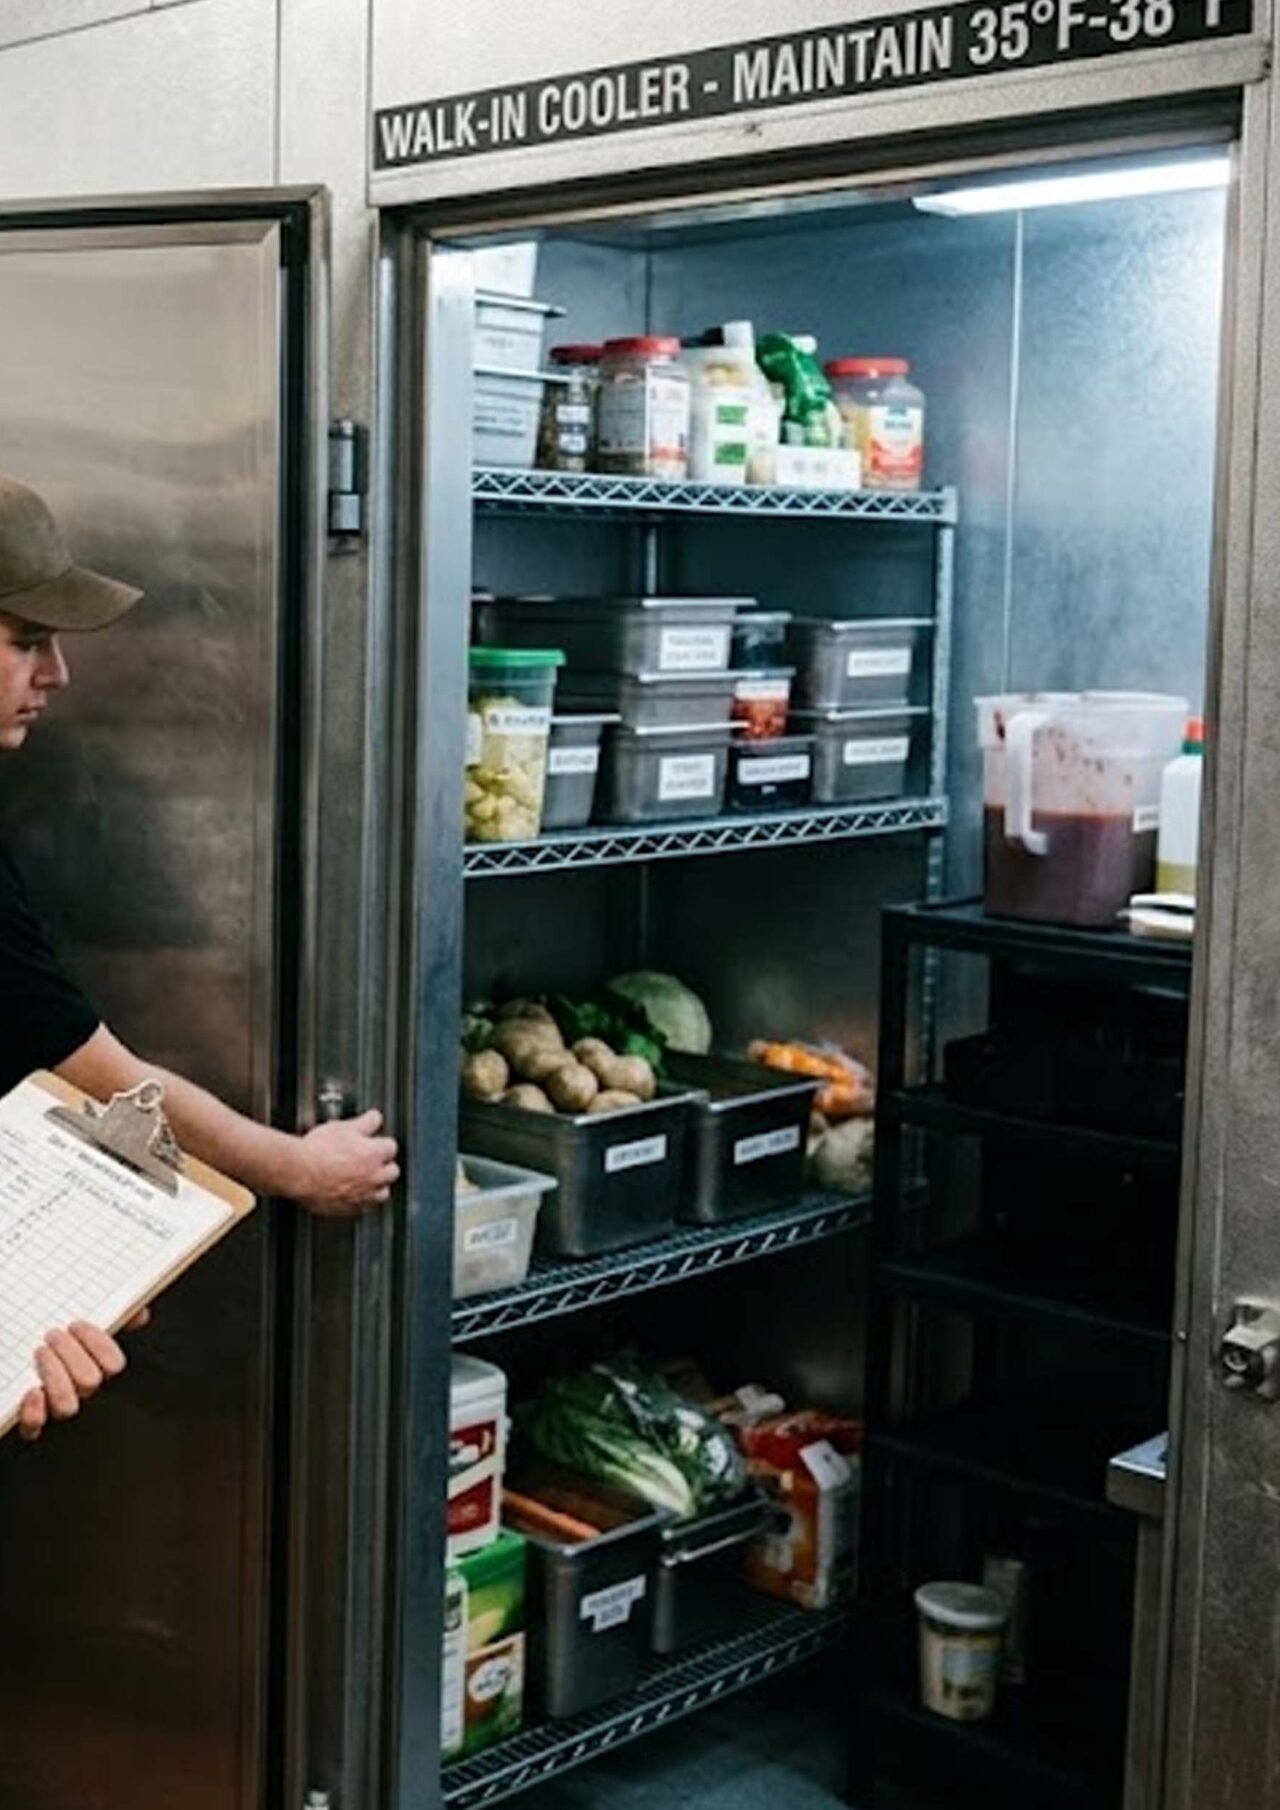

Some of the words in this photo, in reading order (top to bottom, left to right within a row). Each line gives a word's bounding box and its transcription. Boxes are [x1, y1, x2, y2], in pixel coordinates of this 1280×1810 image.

[379, 91, 526, 160] WALK-IN
[538, 63, 690, 135] COOLER
[733, 15, 952, 104] MAINTAIN
[969, 0, 1220, 65] 35°F-38
